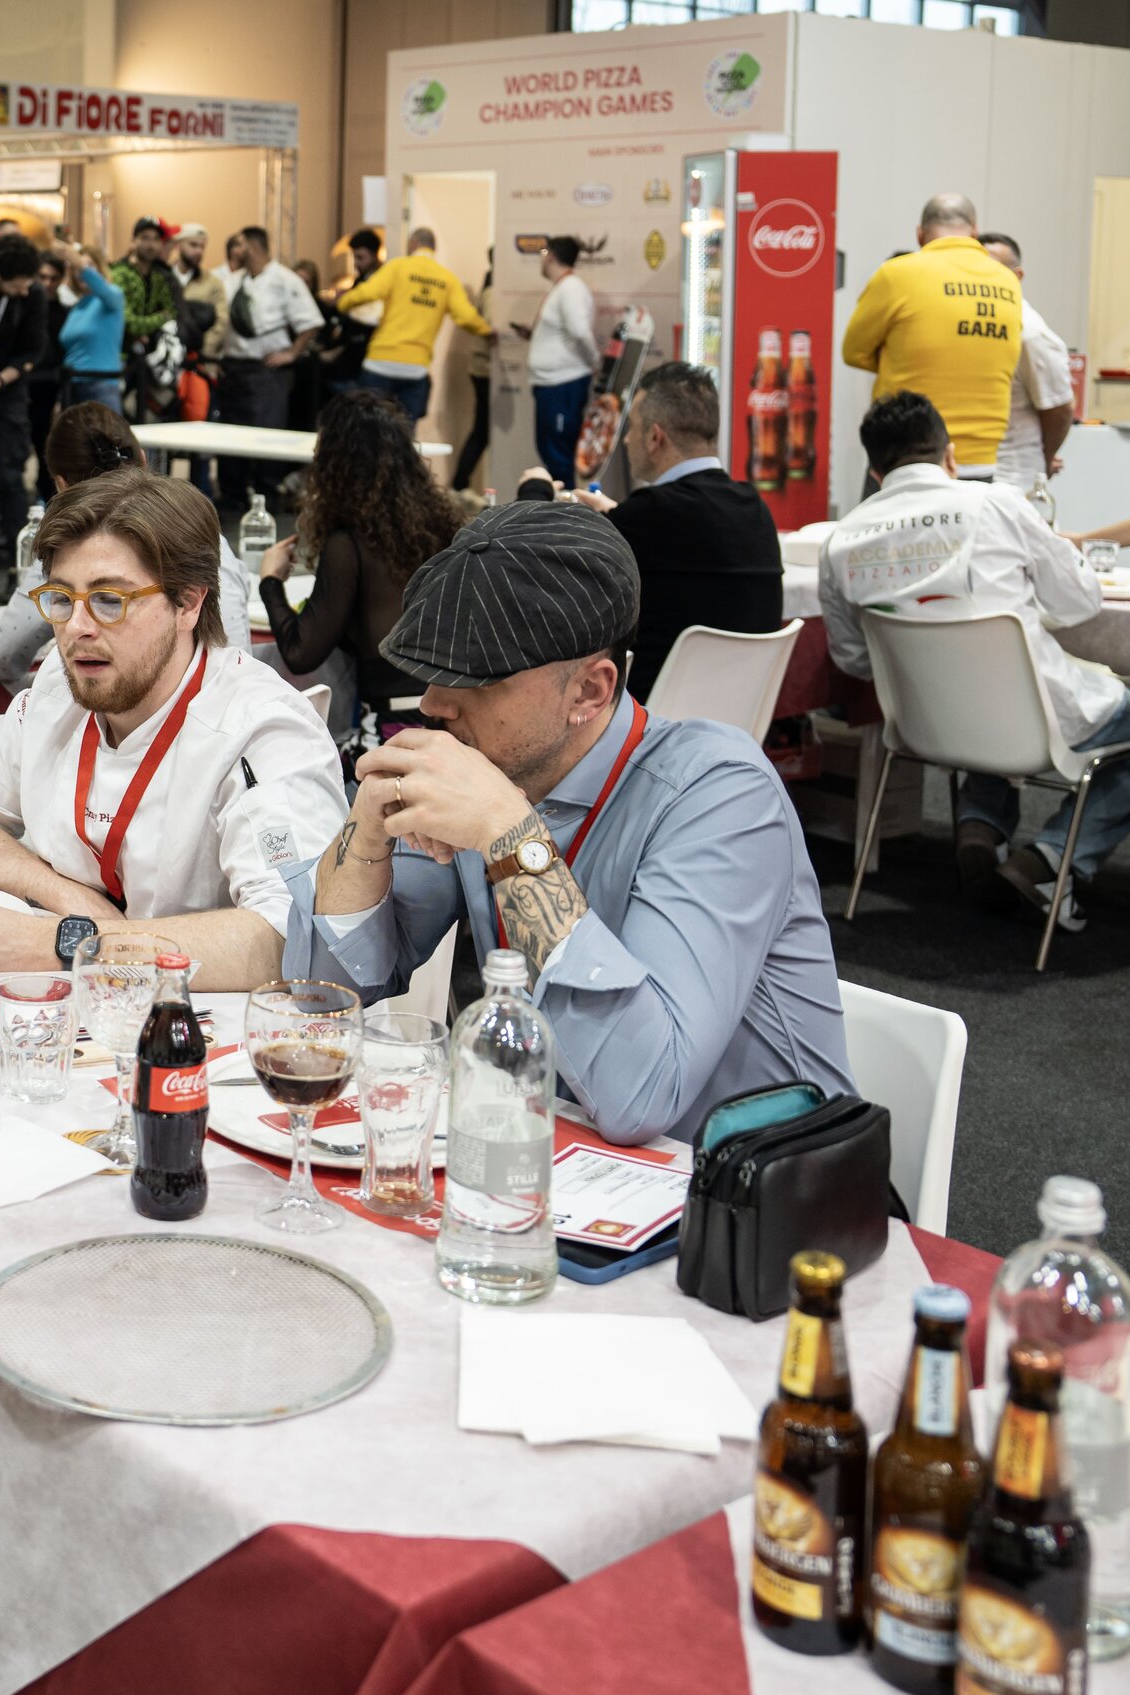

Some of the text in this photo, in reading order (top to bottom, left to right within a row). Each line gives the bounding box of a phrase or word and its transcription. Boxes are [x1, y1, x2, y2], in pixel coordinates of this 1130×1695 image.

[503, 65, 642, 96] WORLD PIZZA
[479, 91, 674, 124] CHAMPION GAMES
[753, 225, 819, 250] Coca-Cola
[976, 302, 995, 318] DI
[958, 321, 1008, 341] GARA
[848, 561, 940, 580] PIZZAIO
[506, 1172, 540, 1185] STILLE
